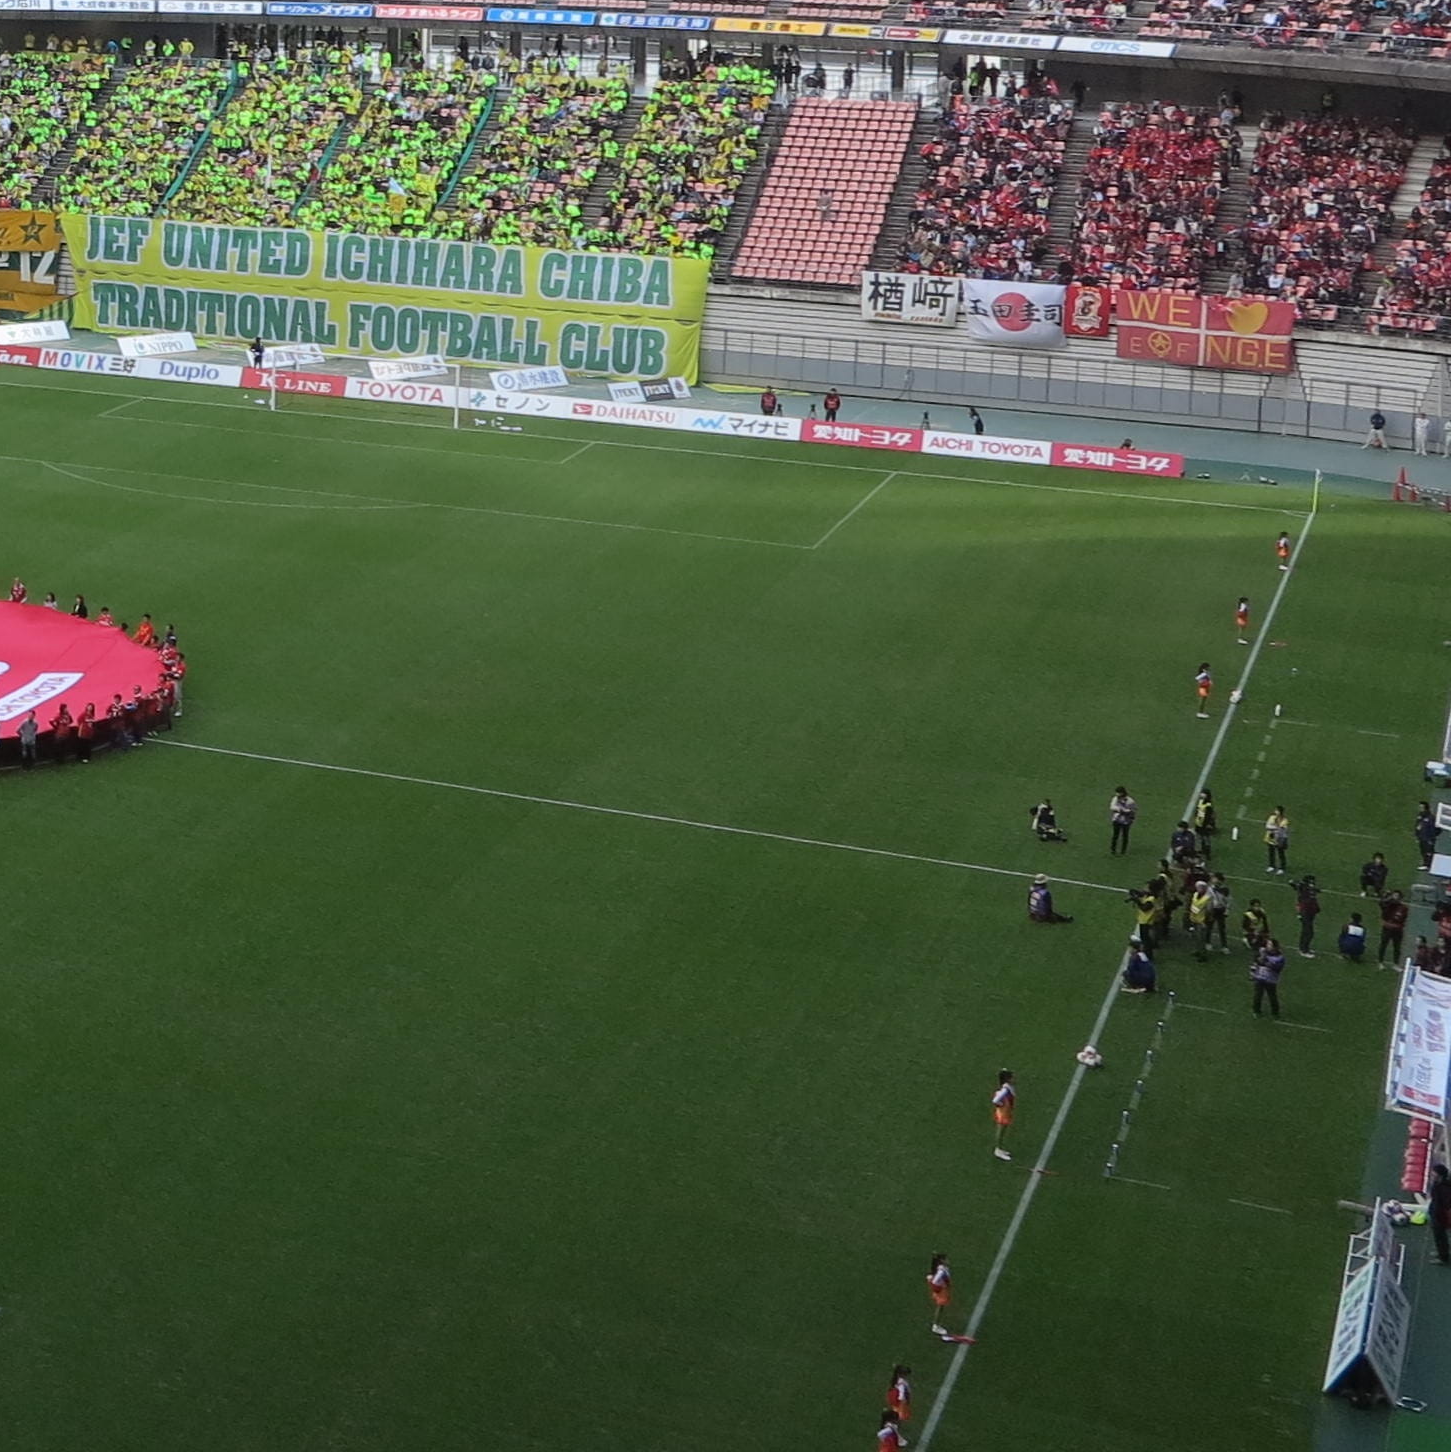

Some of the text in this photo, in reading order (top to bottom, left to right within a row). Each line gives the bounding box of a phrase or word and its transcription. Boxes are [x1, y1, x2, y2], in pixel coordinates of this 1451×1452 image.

[85, 215, 674, 313] JEF UNITED ICHIHARA CHIBA
[967, 297, 1063, 325] 玉田圭司
[1127, 292, 1196, 328] WE
[90, 278, 670, 384] TRADITIONAL FOOTBALL CLUB
[43, 349, 136, 374] MOVIX 三好
[158, 360, 220, 381] Duplo
[283, 377, 332, 394] LINE
[516, 370, 562, 387] 清水建設
[355, 380, 444, 403] TOYOTA
[494, 394, 551, 412] セノン
[595, 404, 677, 423] DAIHATSU
[728, 416, 790, 436] マイナビ
[811, 424, 913, 447] 愛知トヨタ
[928, 436, 1044, 459] AICHI TOYOTA
[1062, 447, 1171, 472] 愛知トヨタ
